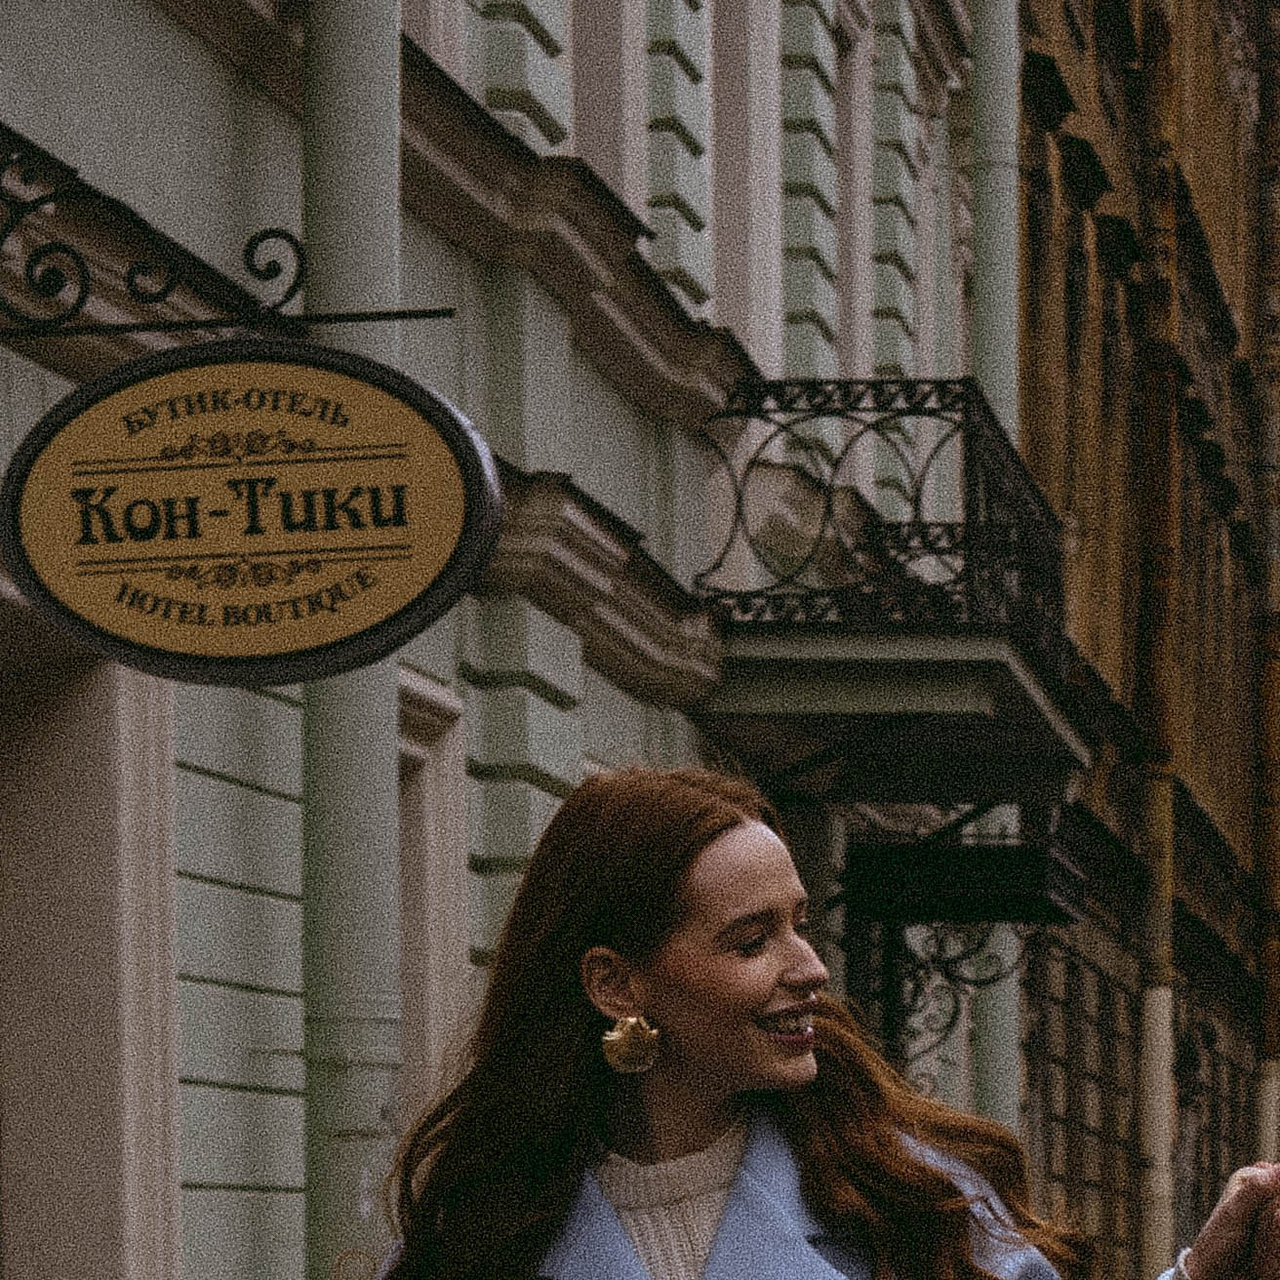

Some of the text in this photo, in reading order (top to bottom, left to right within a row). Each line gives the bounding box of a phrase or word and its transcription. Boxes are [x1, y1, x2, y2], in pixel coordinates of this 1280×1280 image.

[122, 388, 351, 437] БУТИК-ОТЕЛЬ
[70, 476, 408, 546] Кон-Тики
[115, 568, 379, 627] HOTEL BOUTIQUE
